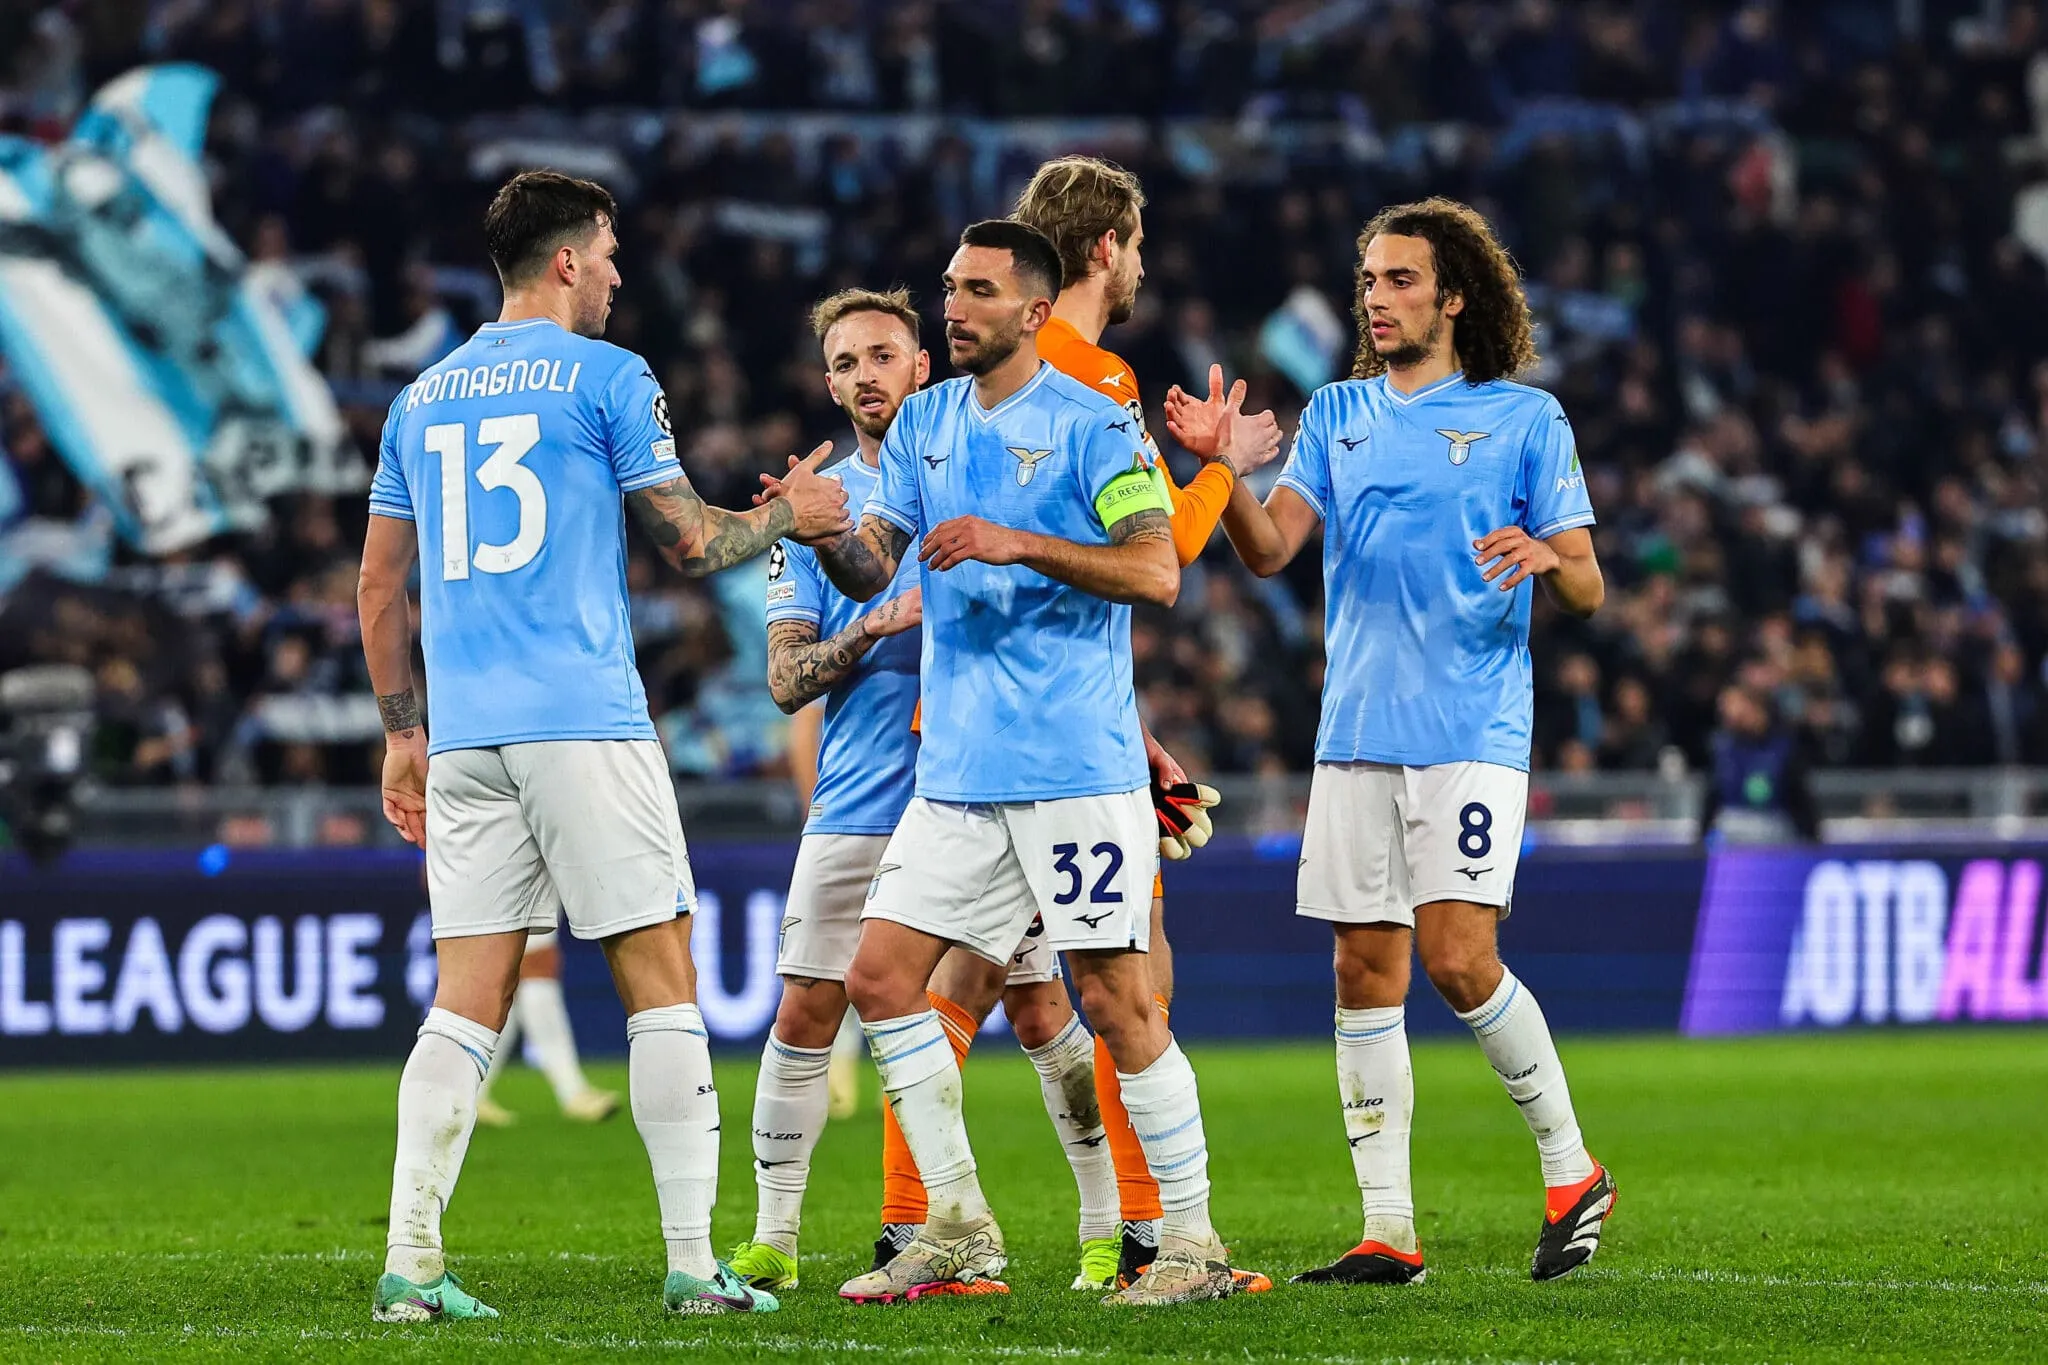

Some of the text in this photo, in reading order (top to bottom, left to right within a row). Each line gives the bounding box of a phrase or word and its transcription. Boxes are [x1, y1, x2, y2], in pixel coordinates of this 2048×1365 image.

[407, 358, 582, 412] ROMAGNOLI
[424, 413, 548, 581] 13
[1556, 476, 1585, 493] Aer
[1458, 802, 1493, 859] 8
[1053, 841, 1124, 905] 32
[0, 913, 386, 1035] LEAGUE
